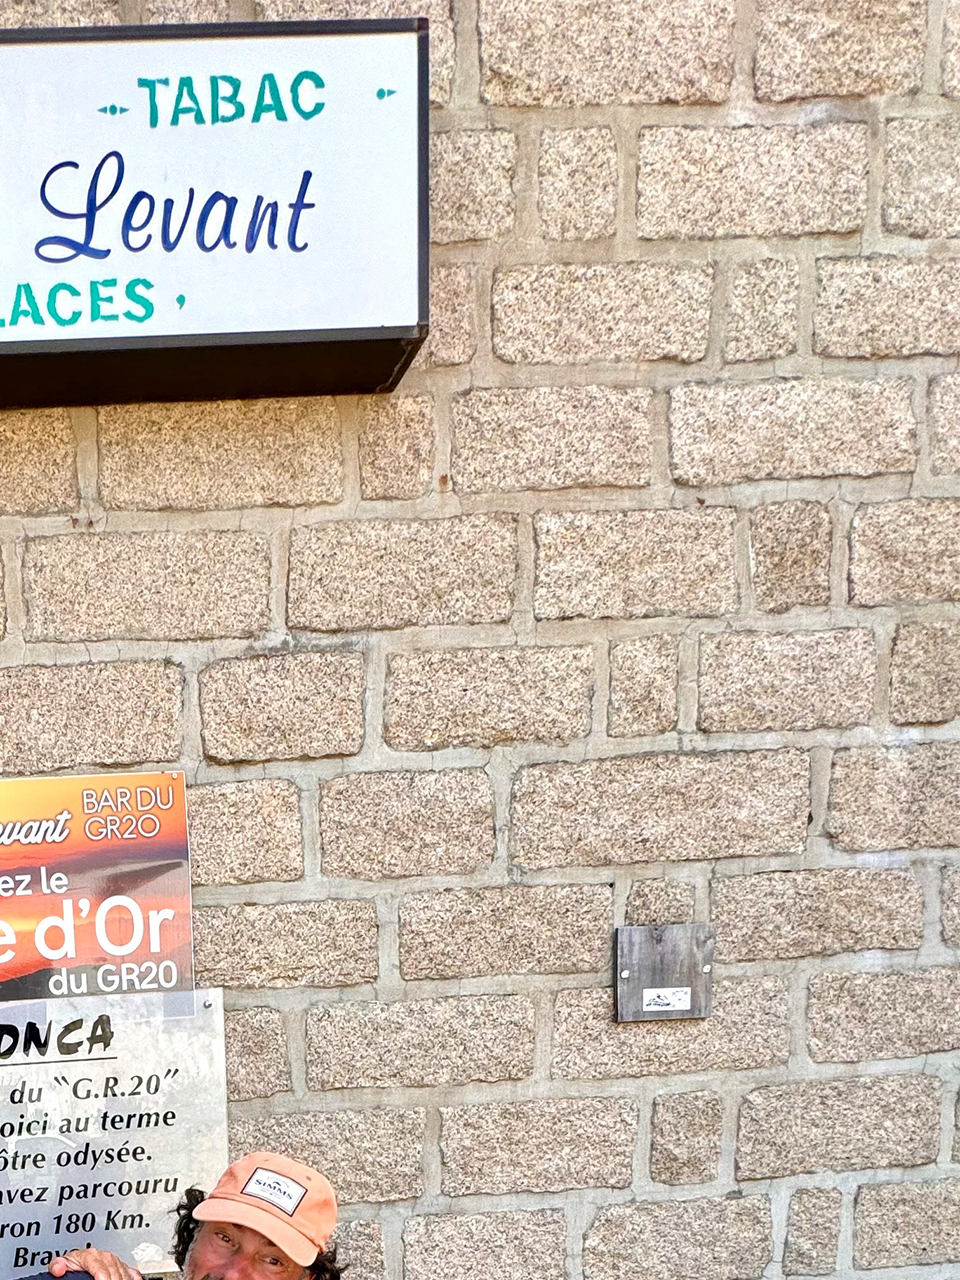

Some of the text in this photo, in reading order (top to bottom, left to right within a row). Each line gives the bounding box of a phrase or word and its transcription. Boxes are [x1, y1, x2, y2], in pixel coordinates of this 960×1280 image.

[137, 70, 326, 129] TABAC
[34, 150, 316, 264] Levant
[82, 786, 174, 814] BAR DU
[40, 866, 69, 894] le
[34, 895, 175, 961] d'Or
[48, 960, 178, 996] du GR20
[10, 1081, 42, 1105] du
[58, 1118, 91, 1135] au
[100, 1109, 177, 1132] terme
[56, 1140, 153, 1172] odysée.
[56, 1176, 179, 1207] parcouru
[254, 1178, 293, 1200] SIMMS
[52, 1211, 96, 1235] 180
[104, 1208, 152, 1232] Km.
